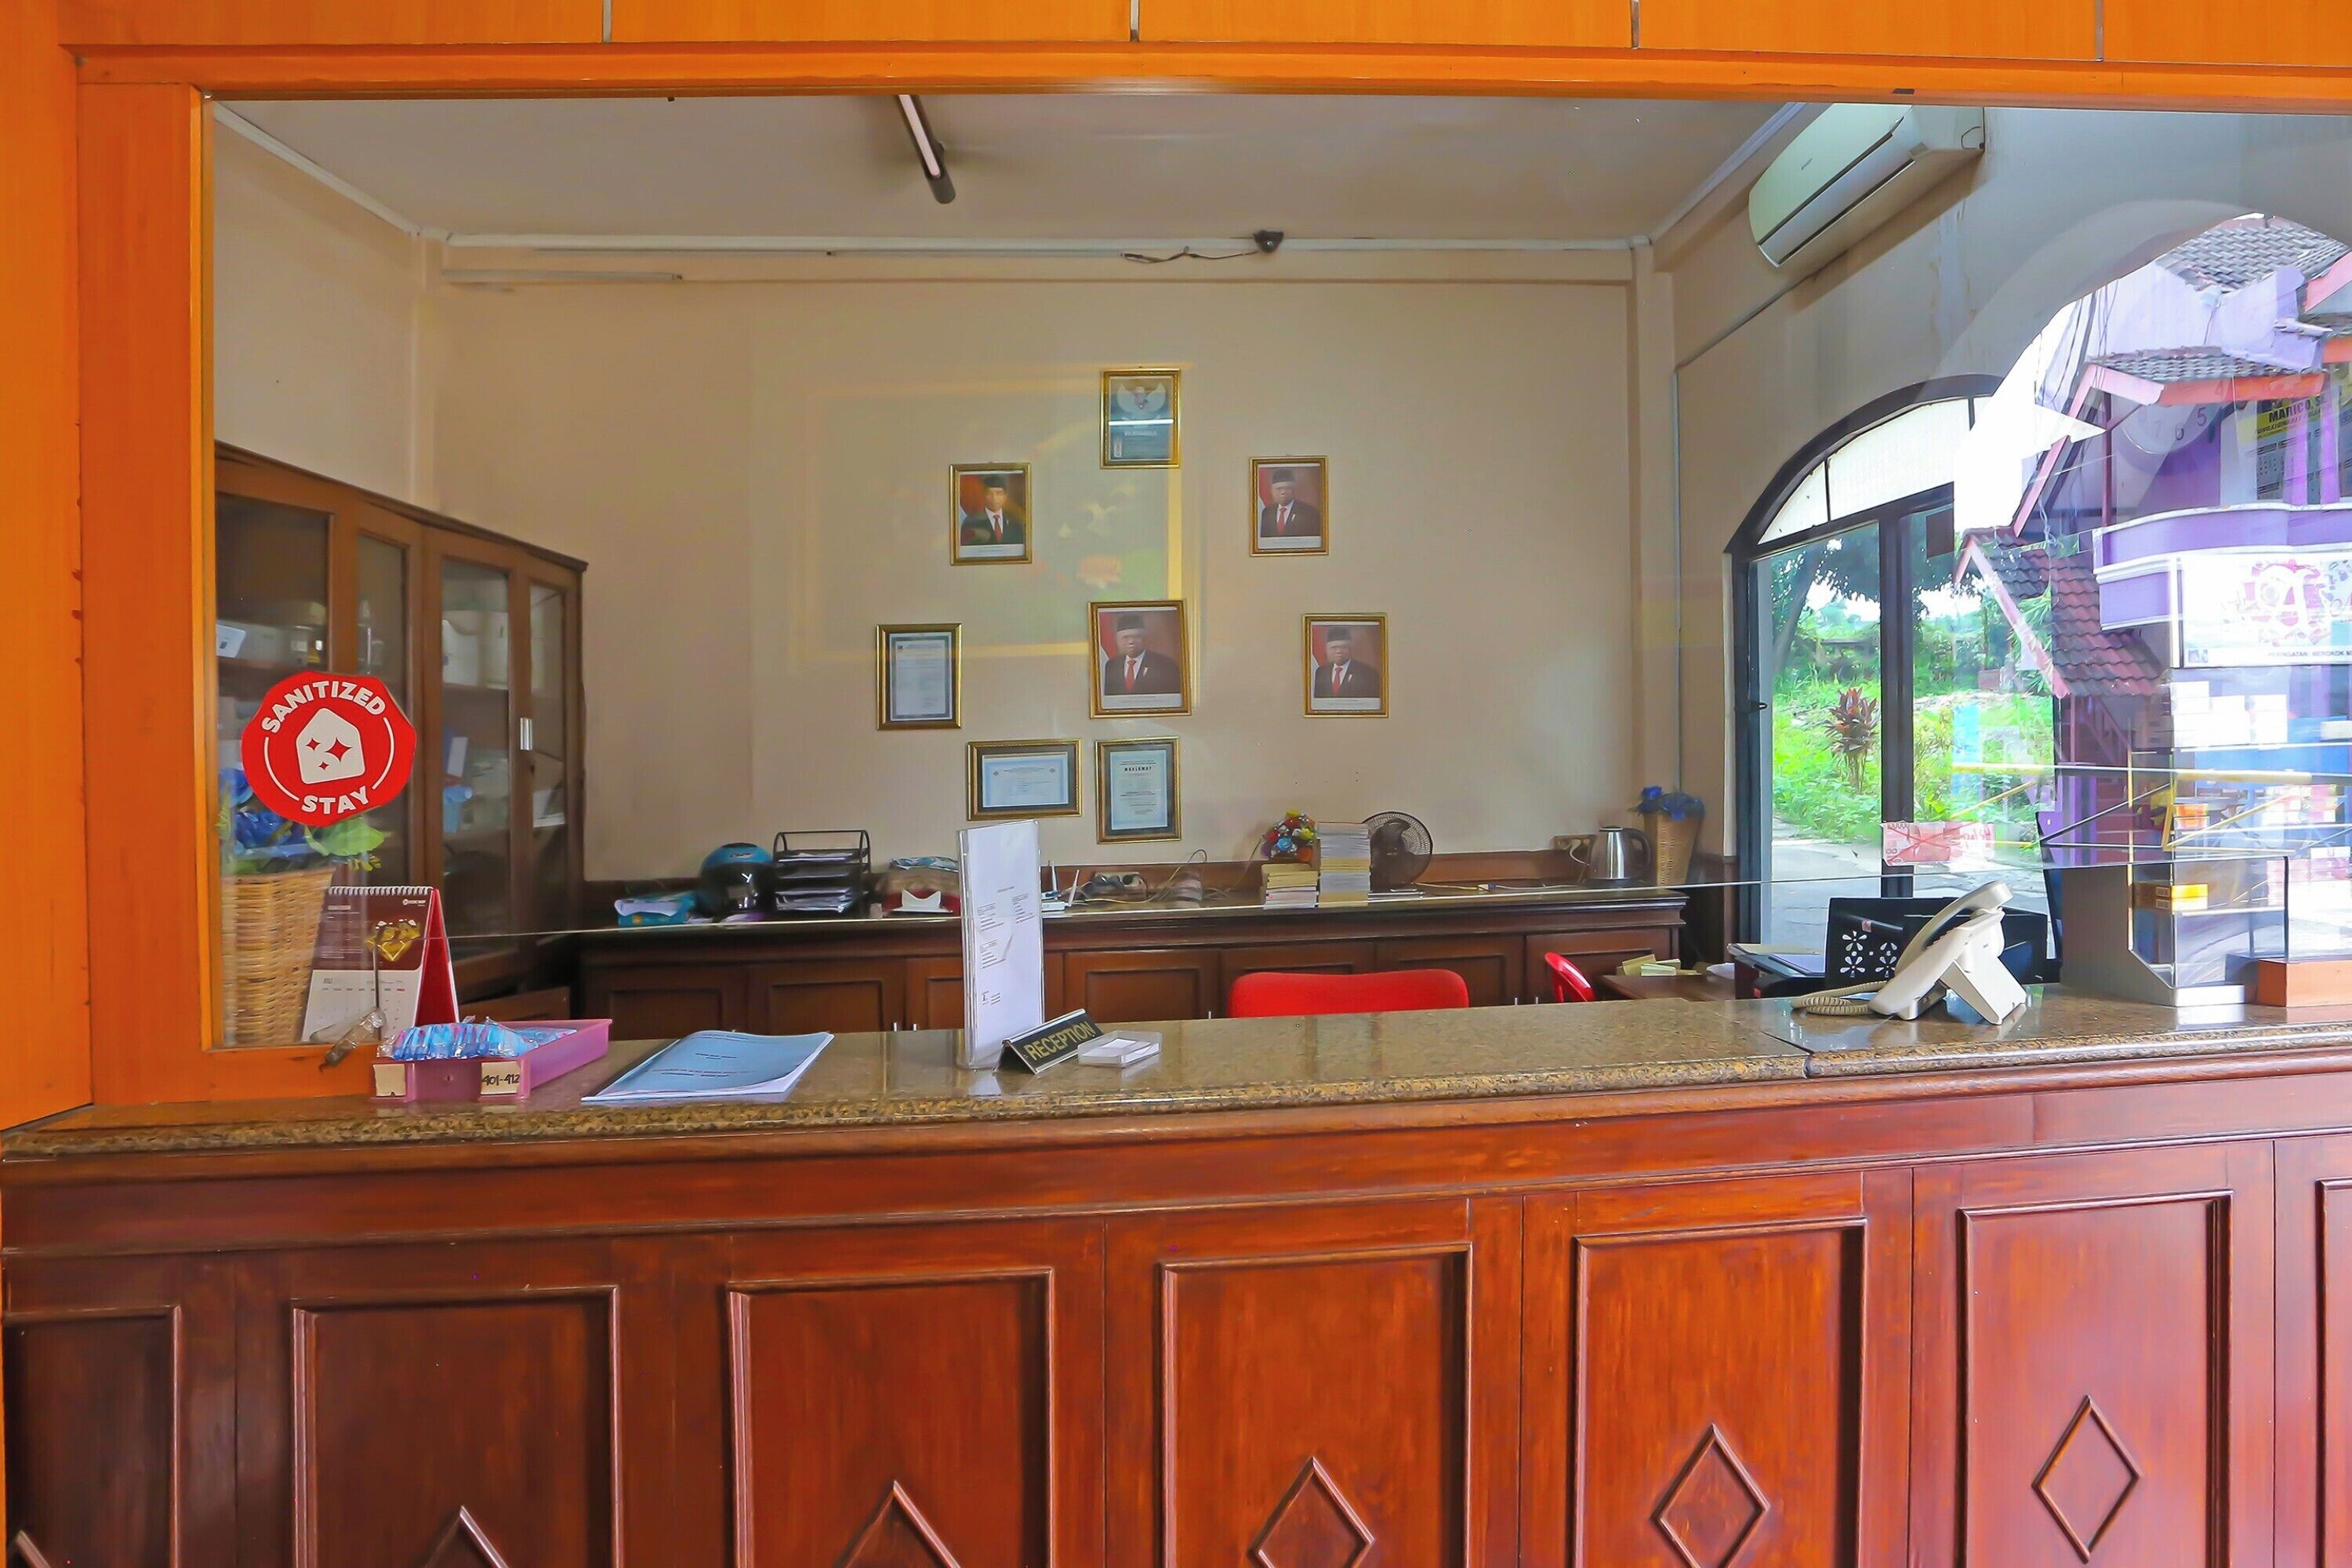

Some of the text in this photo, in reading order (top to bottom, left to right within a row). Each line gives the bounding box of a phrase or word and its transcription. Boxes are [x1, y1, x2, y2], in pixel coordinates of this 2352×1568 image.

[2196, 406, 2207, 426] 5
[262, 681, 386, 734] SANITIZED
[301, 786, 369, 815] STAY
[1023, 1021, 1096, 1061] RECEPTION
[481, 1073, 521, 1086] 401-412
